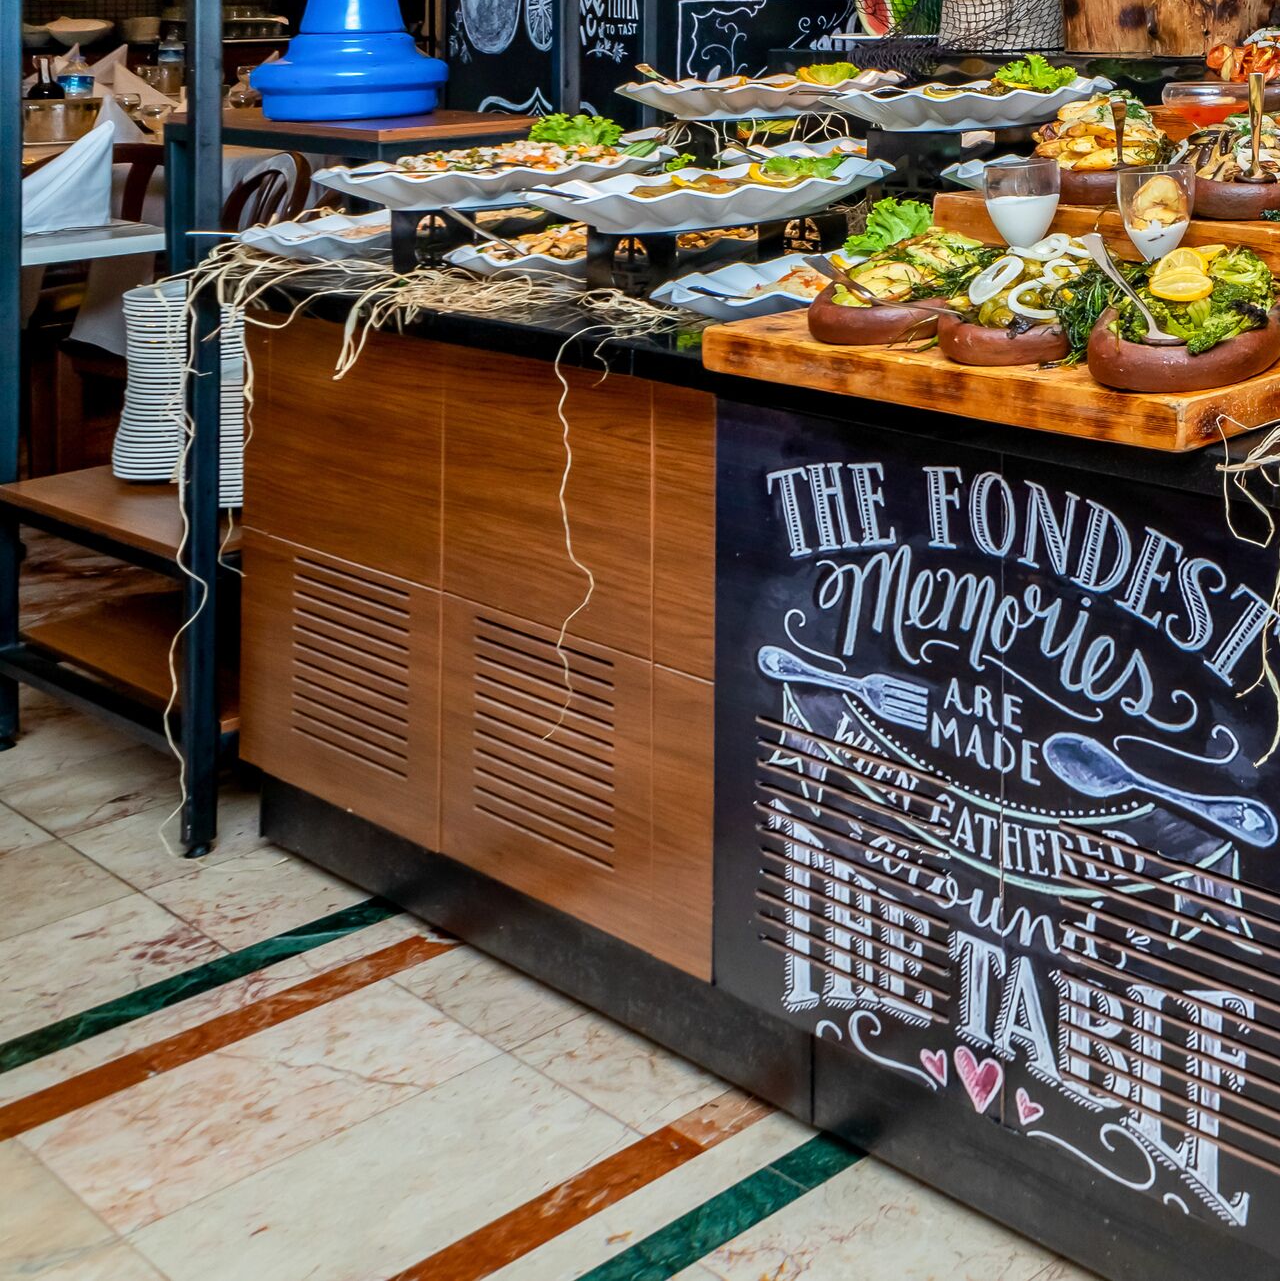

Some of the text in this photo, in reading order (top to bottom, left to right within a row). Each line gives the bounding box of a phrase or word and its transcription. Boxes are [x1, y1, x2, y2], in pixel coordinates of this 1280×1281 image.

[618, 22, 638, 35] TAST
[767, 462, 897, 557] THE
[815, 544, 1197, 731] Memories
[930, 712, 1042, 786] MADE
[943, 677, 1024, 733] ARE
[929, 793, 1146, 883] GATHERED
[781, 798, 934, 1028] THE
[947, 929, 1255, 1227] TABLE
